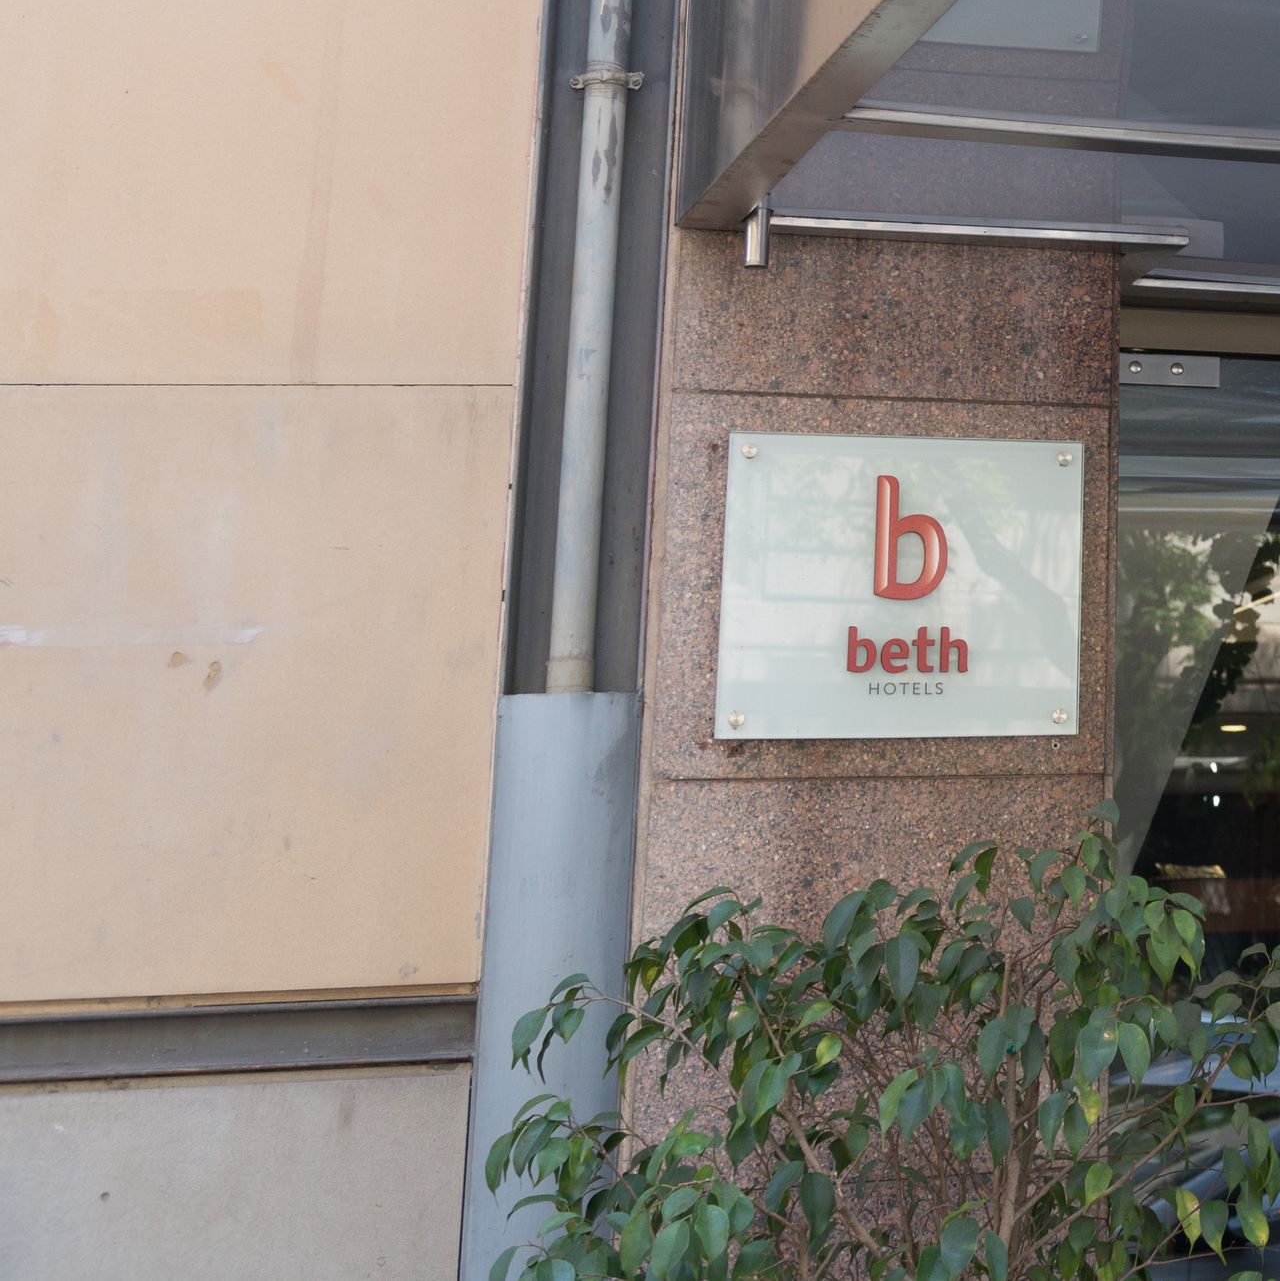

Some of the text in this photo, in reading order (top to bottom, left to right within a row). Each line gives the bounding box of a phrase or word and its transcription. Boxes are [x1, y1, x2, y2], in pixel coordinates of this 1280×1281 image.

[873, 474, 949, 601] b
[846, 625, 969, 674] beth
[868, 681, 945, 696] HOTELS
